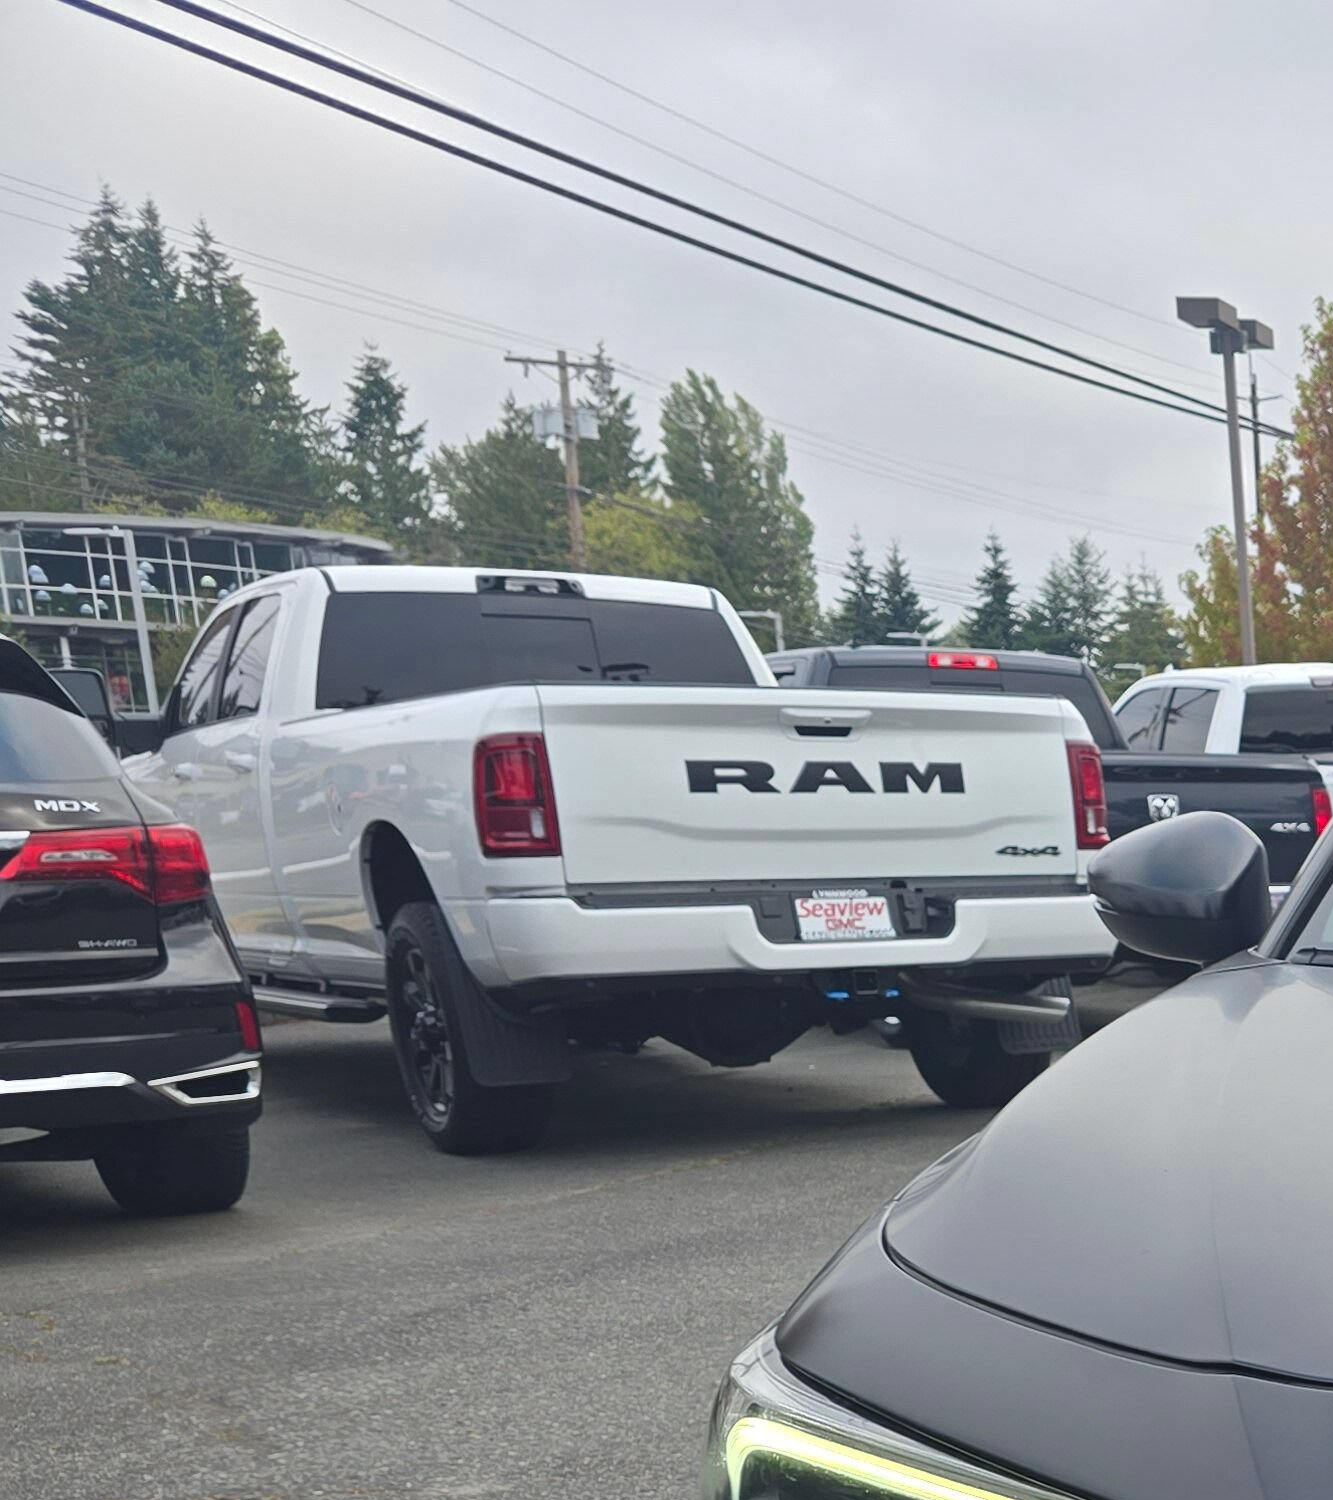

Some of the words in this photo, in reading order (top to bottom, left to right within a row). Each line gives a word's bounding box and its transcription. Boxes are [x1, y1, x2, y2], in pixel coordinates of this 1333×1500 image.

[684, 759, 966, 794] RAM
[34, 799, 101, 813] MDX
[799, 899, 885, 918] Seaview
